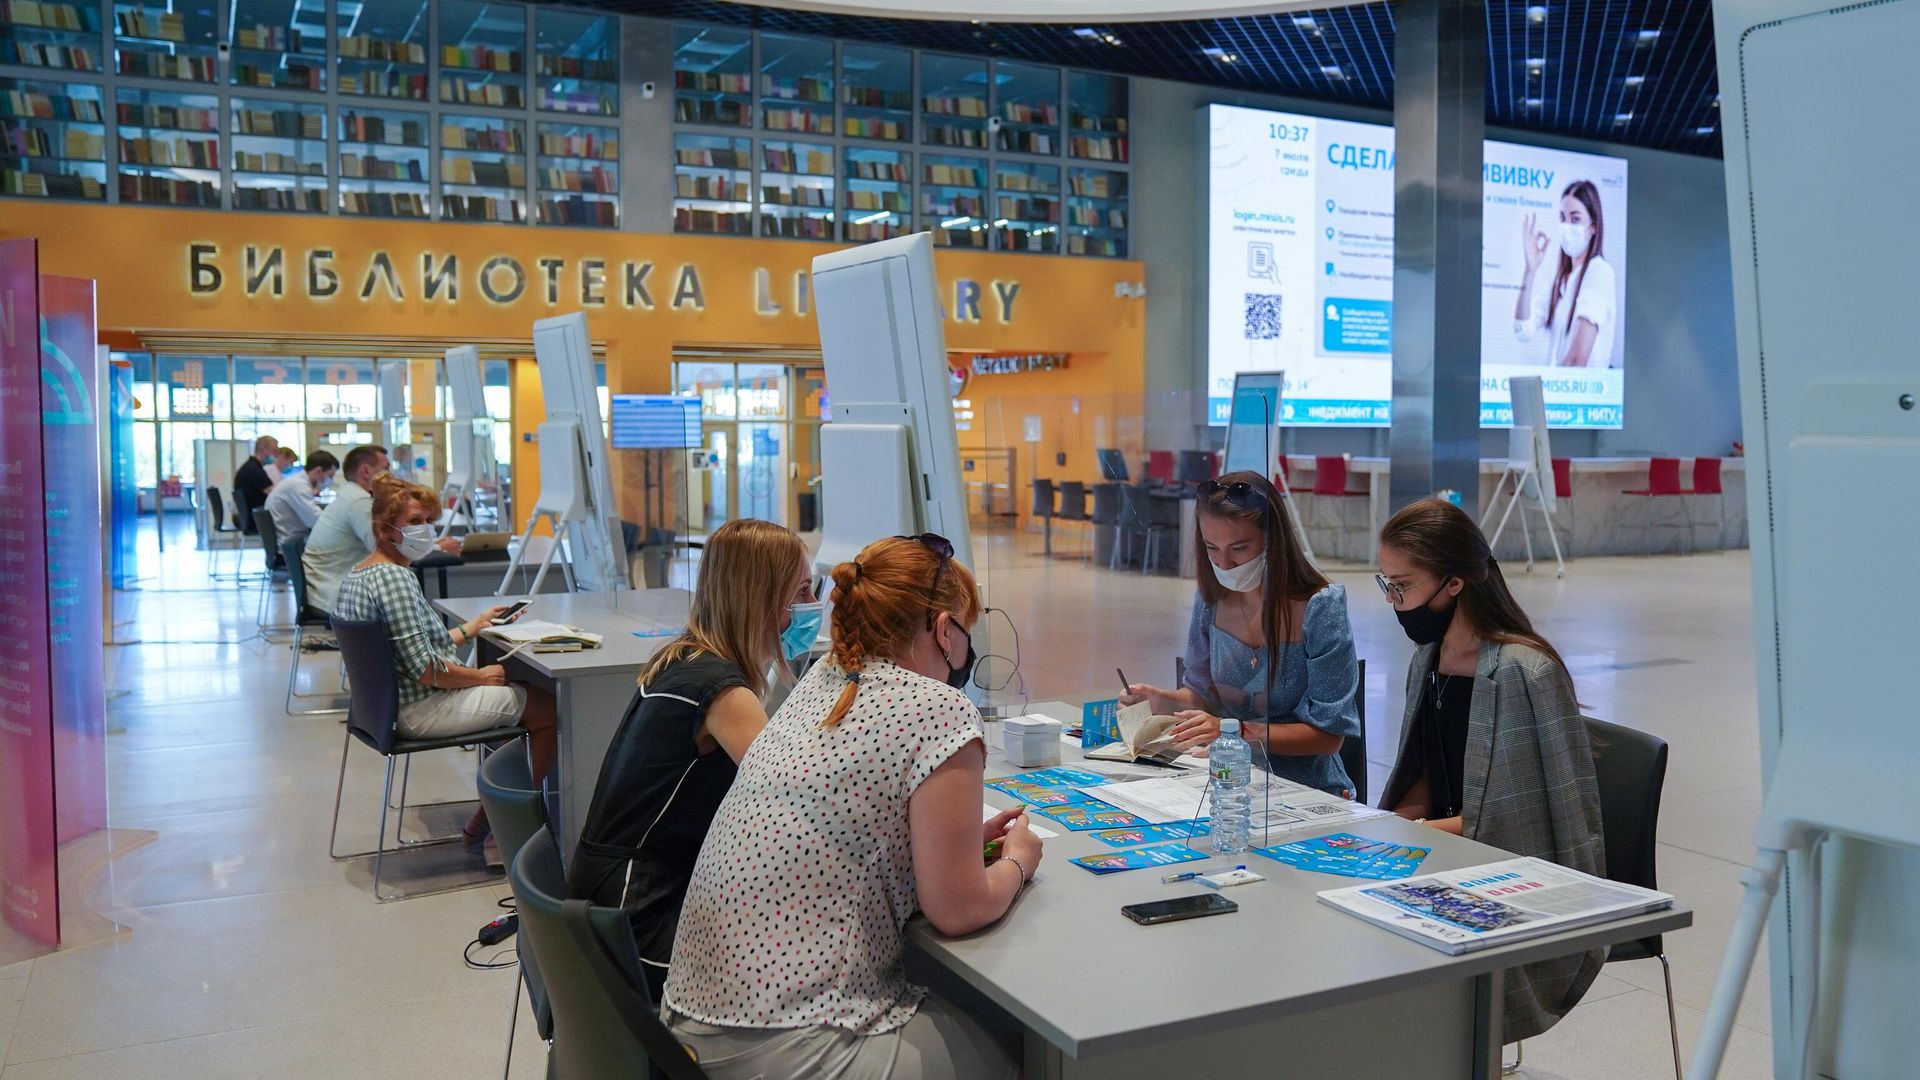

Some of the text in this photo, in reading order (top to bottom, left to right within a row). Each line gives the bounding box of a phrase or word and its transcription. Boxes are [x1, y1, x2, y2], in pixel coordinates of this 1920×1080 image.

[1269, 122, 1309, 142] 10:37
[1280, 166, 1309, 177] среда
[190, 243, 706, 309] БИБЛИОТЕКА
[753, 267, 1021, 324] LIRY
